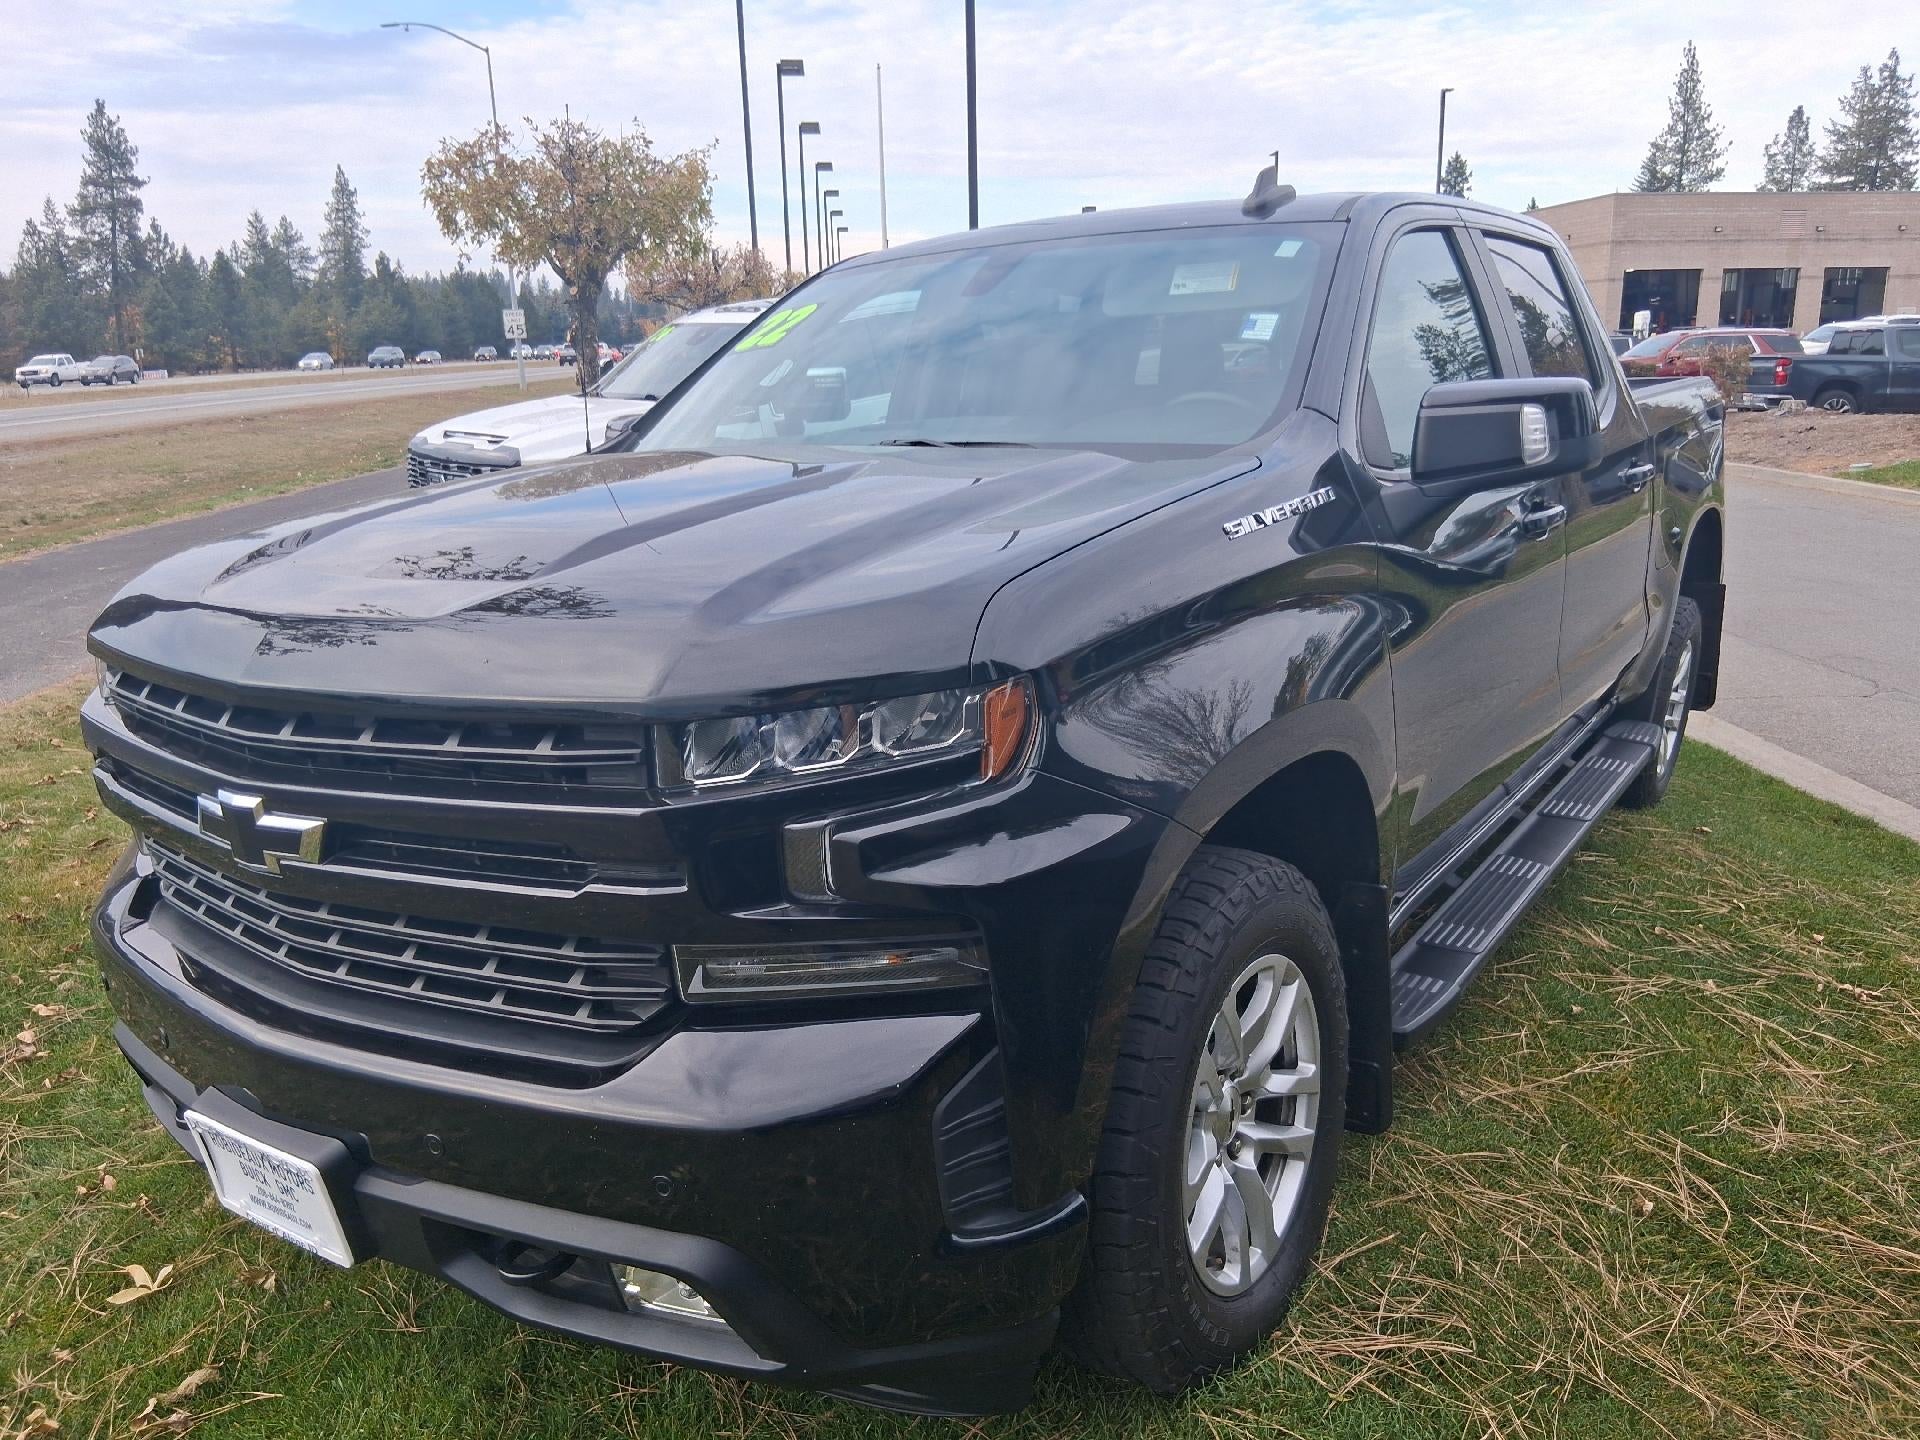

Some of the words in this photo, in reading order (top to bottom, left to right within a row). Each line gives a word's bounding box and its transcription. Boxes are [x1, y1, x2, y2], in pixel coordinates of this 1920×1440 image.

[508, 324, 525, 337] 45
[734, 303, 818, 352] 22
[1222, 486, 1337, 541] SILVERADO
[238, 1159, 272, 1188] BUICK
[274, 1179, 300, 1202] GMC
[267, 1158, 316, 1195] MOTORS
